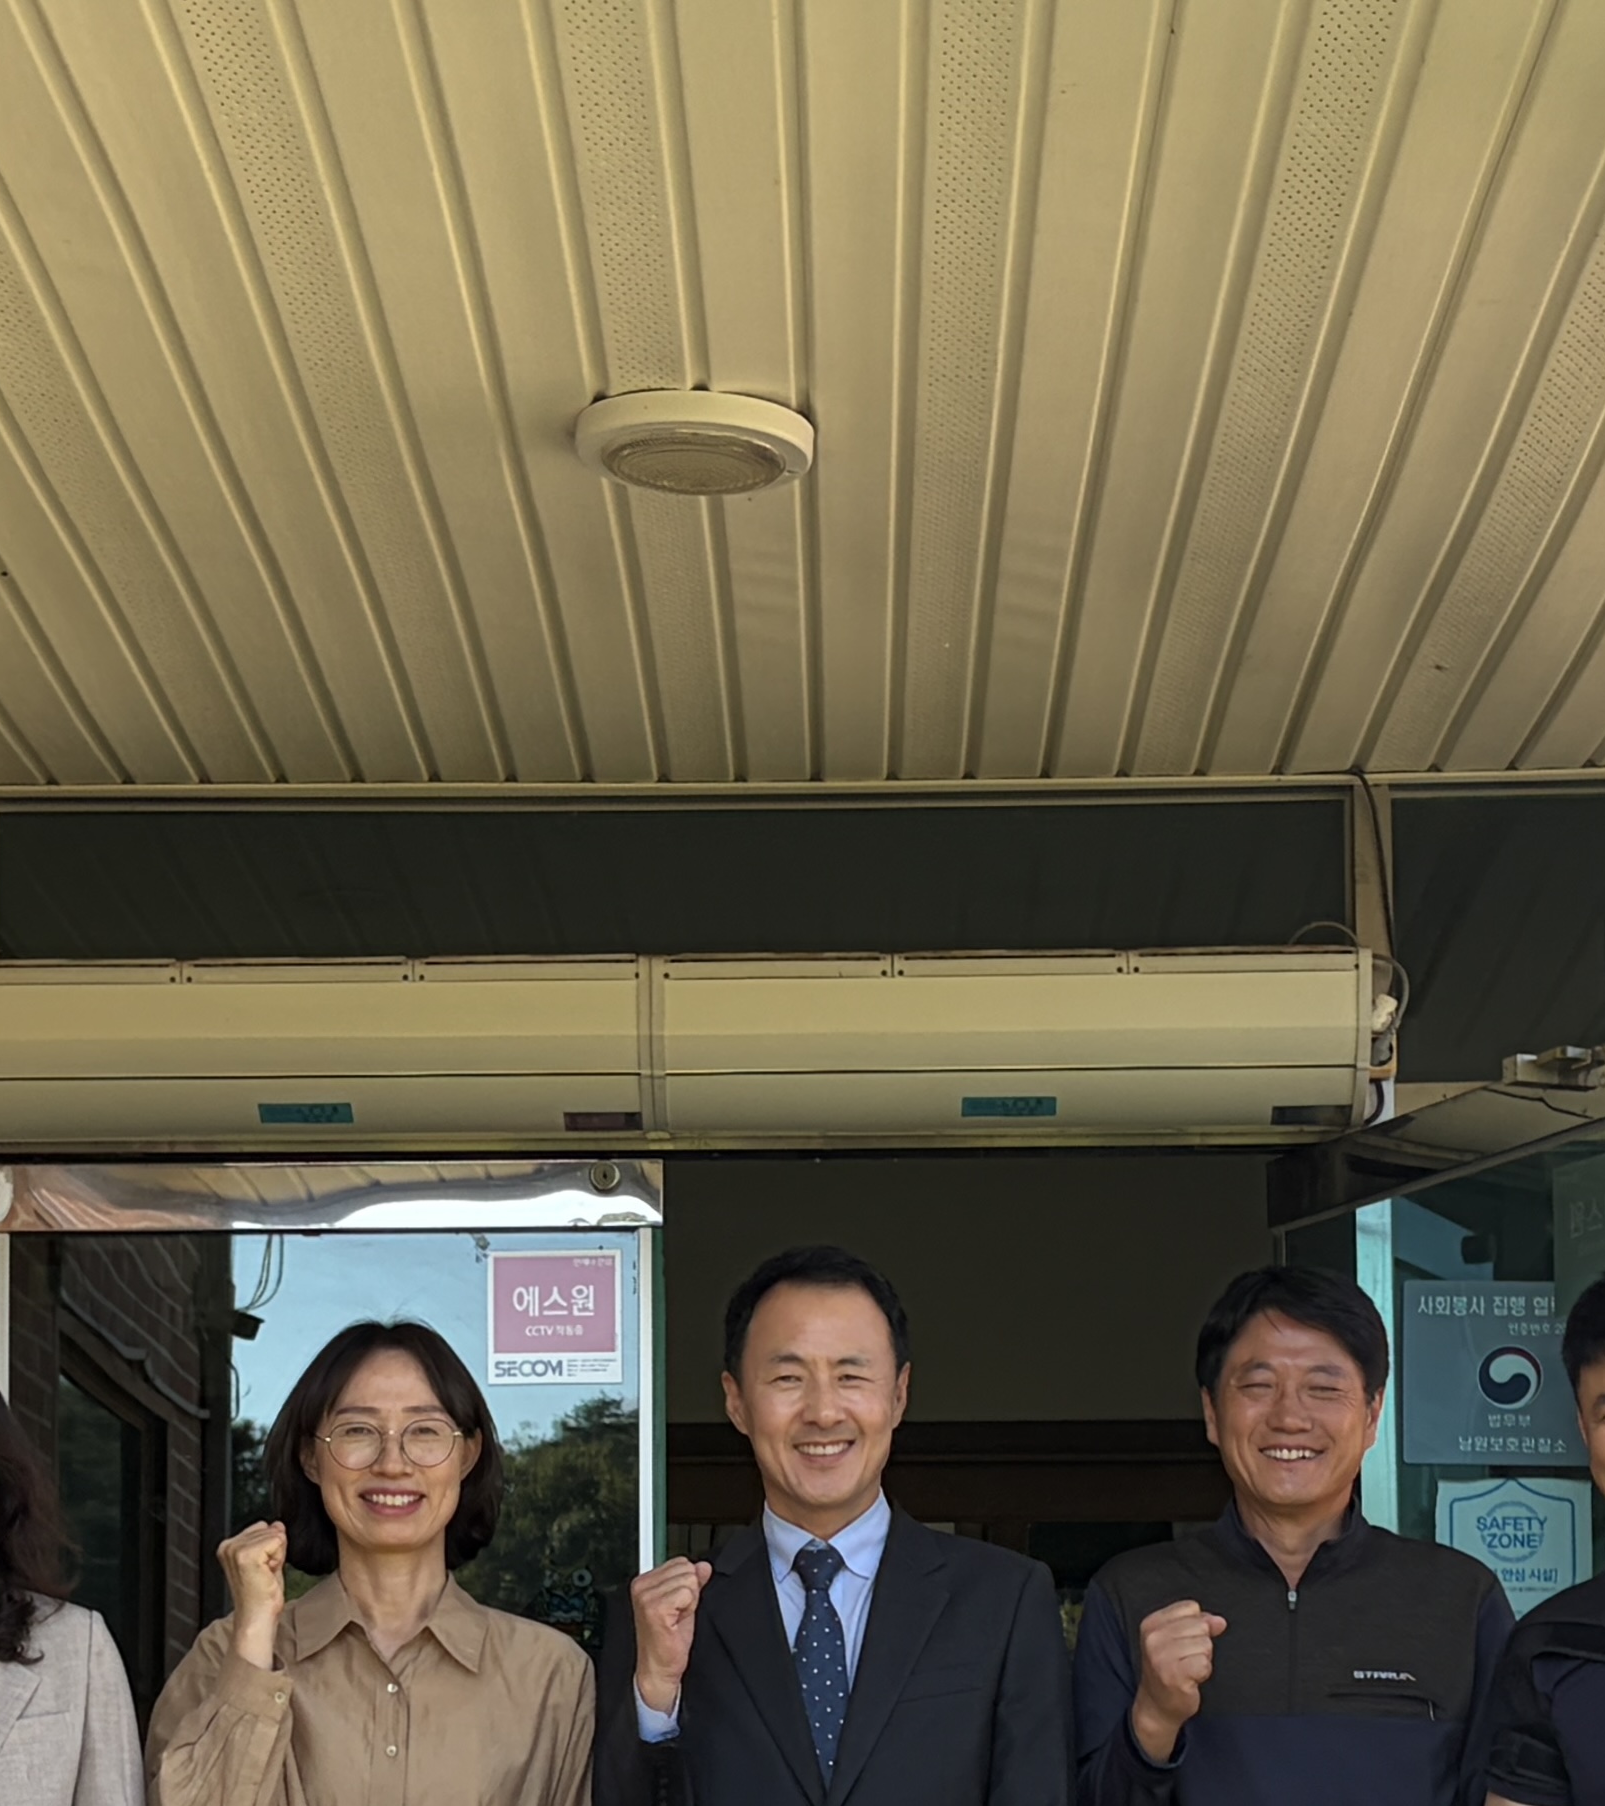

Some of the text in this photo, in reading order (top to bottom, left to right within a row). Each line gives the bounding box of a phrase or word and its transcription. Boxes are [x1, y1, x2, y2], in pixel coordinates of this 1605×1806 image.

[512, 1285, 596, 1317] 에스원
[1418, 1295, 1485, 1317] 사회봉사
[1493, 1295, 1526, 1317] 집행
[525, 1325, 554, 1337] CCTV
[494, 1360, 563, 1378] SECOM
[1488, 1413, 1531, 1428] 법무부
[1458, 1436, 1568, 1454] 남원보호관찰소
[1476, 1515, 1548, 1532] SAFETY
[1486, 1533, 1540, 1549] ZONE
